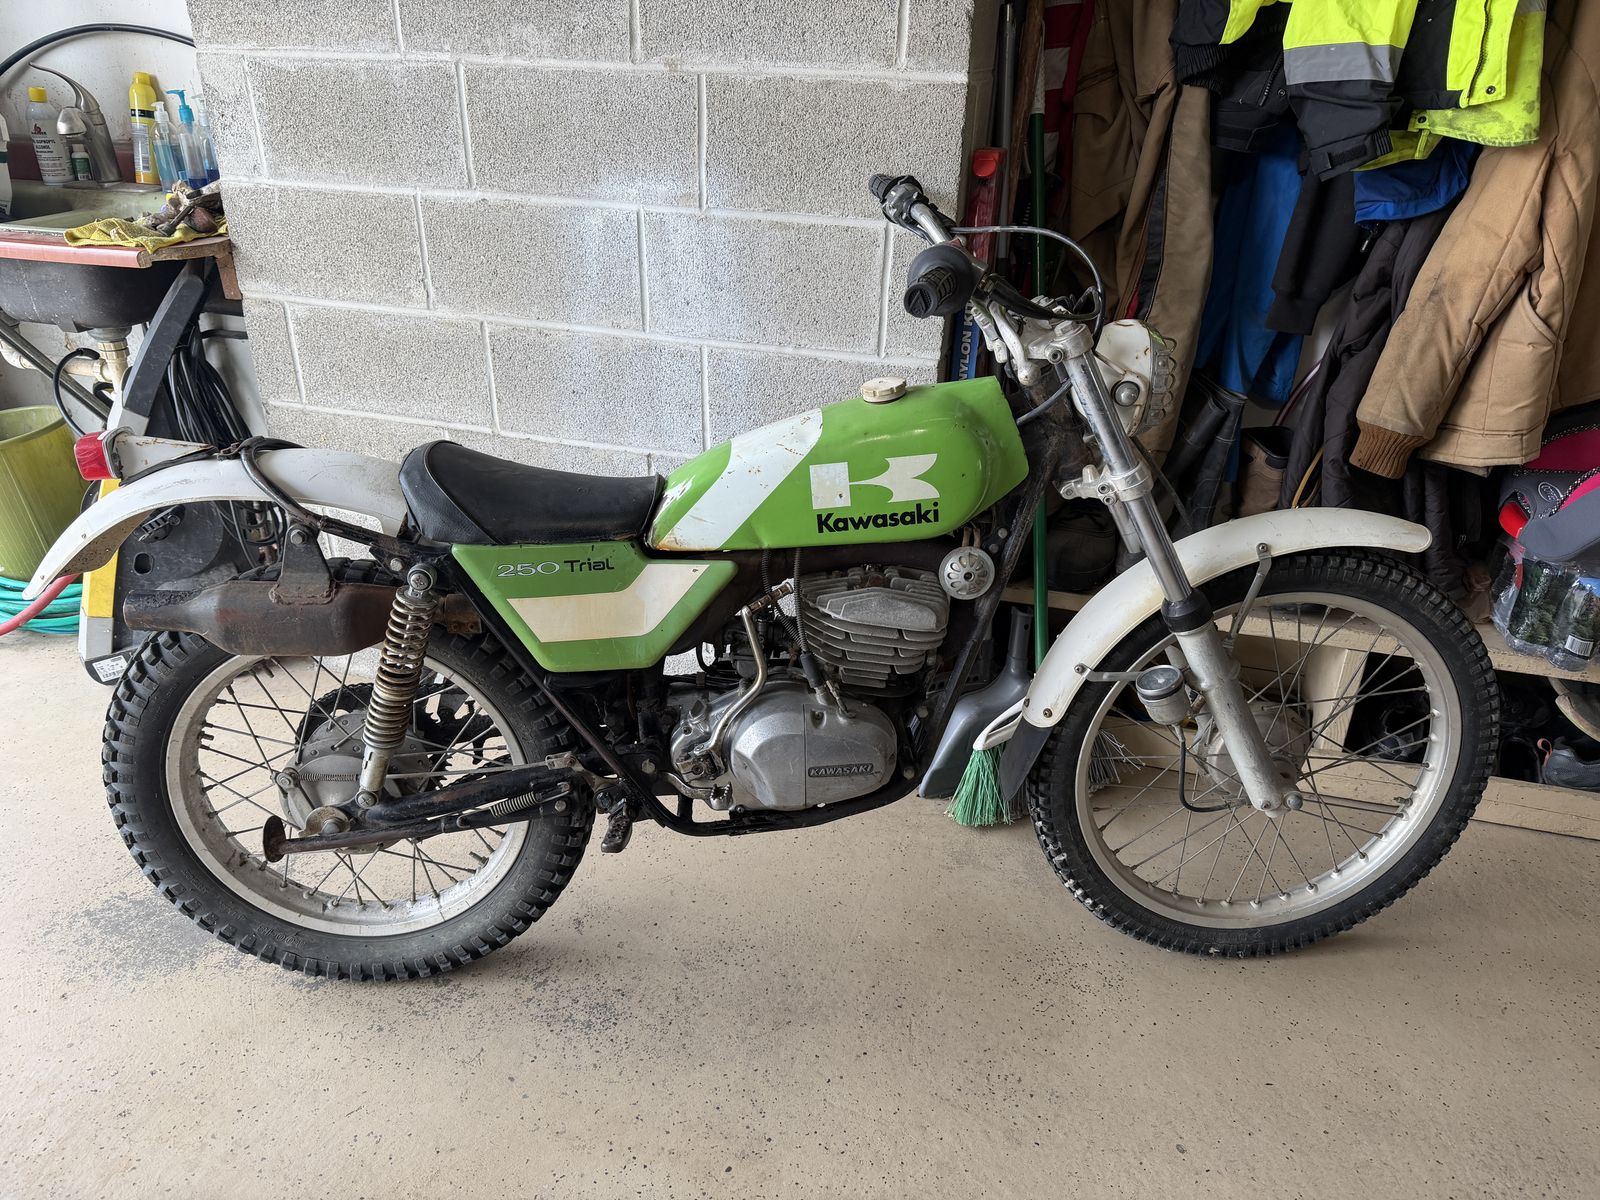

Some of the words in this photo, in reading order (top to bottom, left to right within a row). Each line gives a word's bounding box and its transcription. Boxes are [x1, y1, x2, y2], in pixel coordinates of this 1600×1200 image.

[816, 501, 940, 534] Kawasaki
[497, 561, 560, 577] 250
[563, 557, 615, 573] Trial
[810, 764, 872, 776] KAWASAKI
